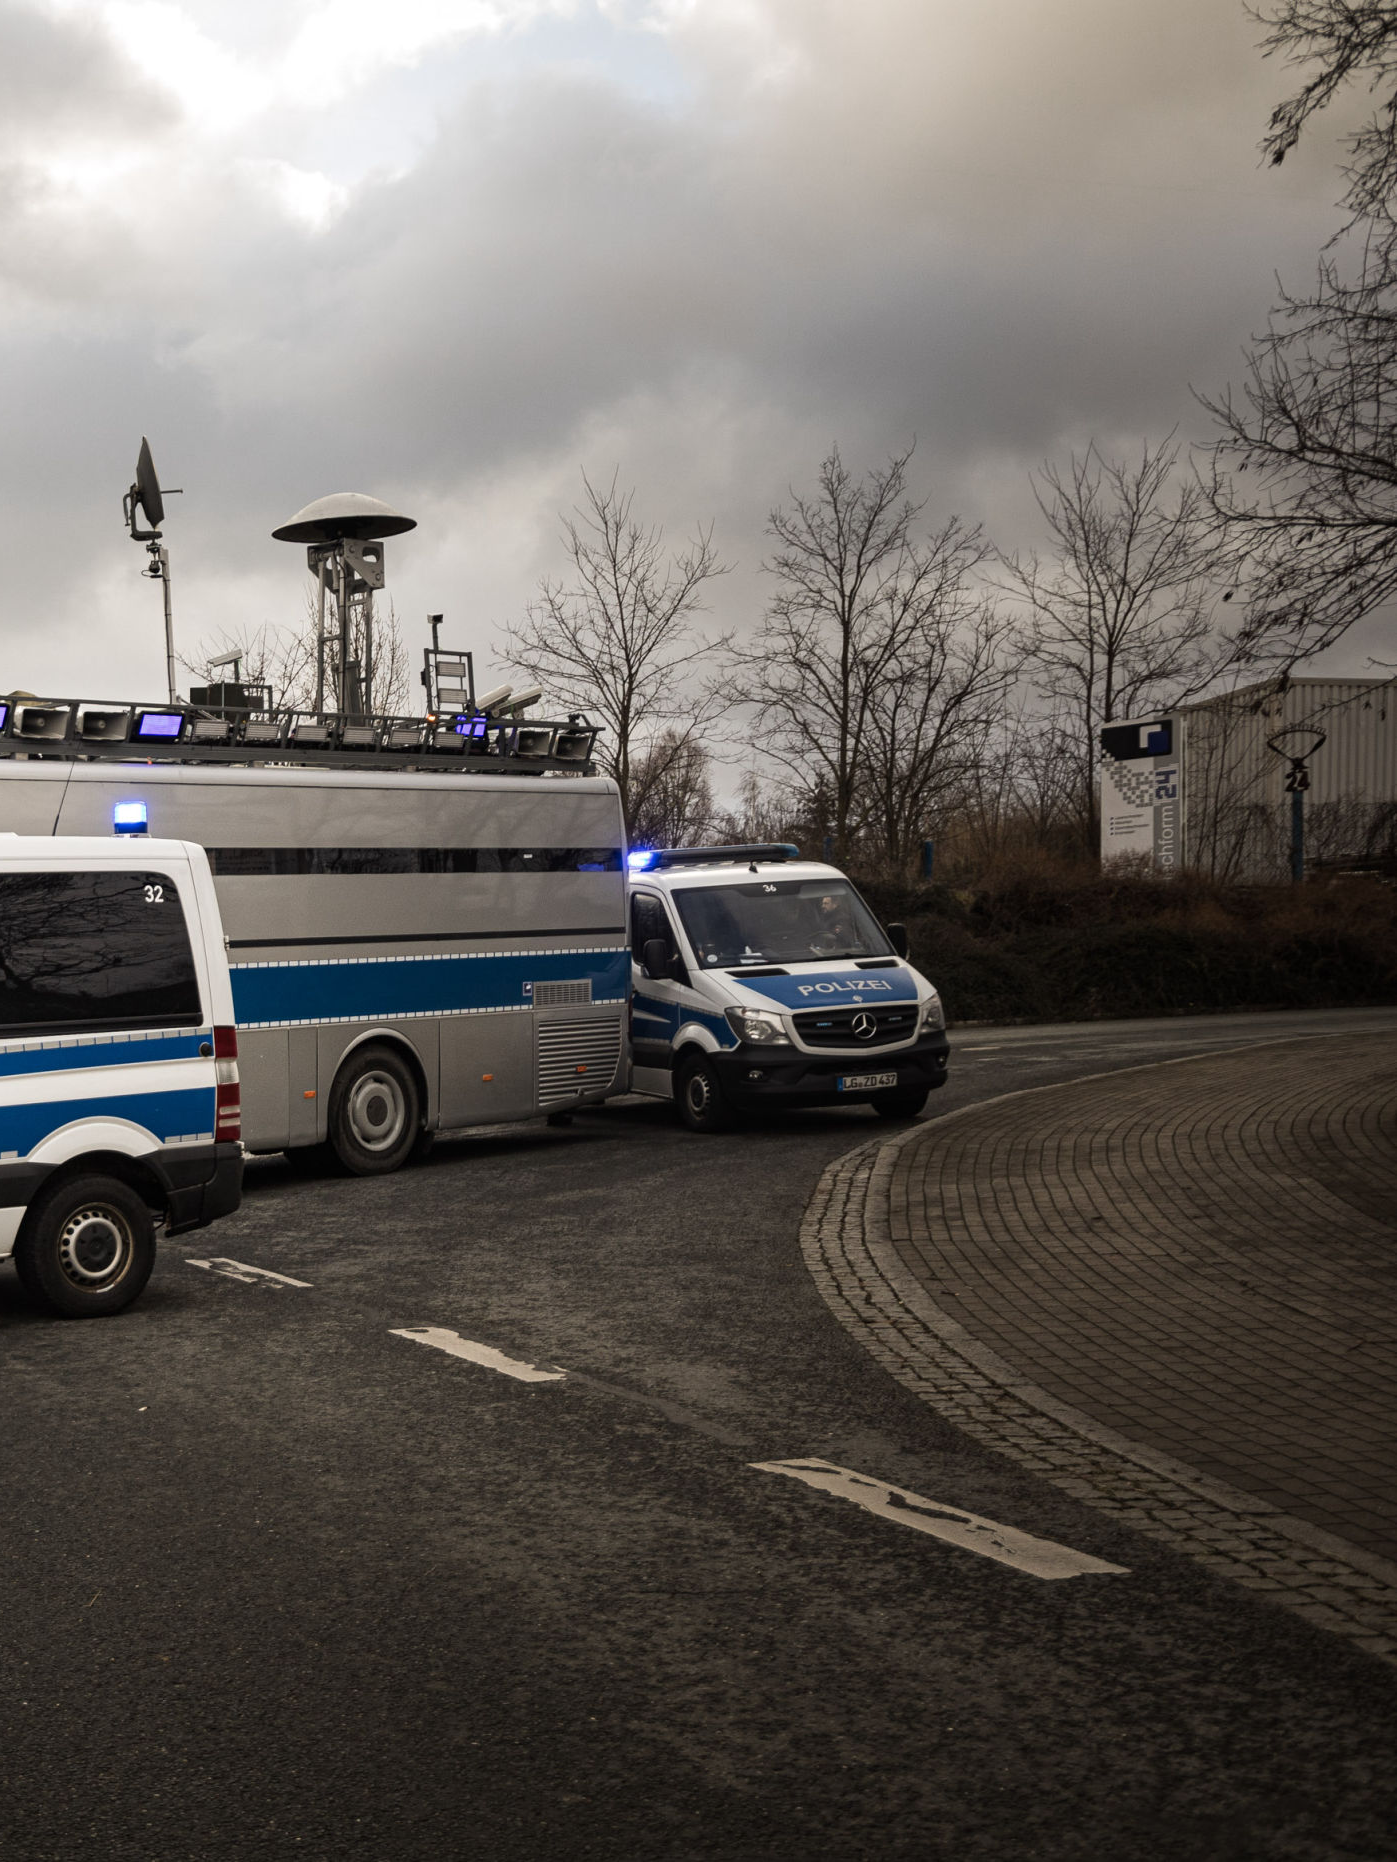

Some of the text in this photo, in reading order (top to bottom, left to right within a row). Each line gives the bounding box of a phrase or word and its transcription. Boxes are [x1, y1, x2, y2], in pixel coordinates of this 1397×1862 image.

[144, 885, 164, 903] 32
[762, 884, 777, 893] 36
[797, 981, 893, 996] POLIZEI
[843, 1074, 896, 1089] LG ZD 437
